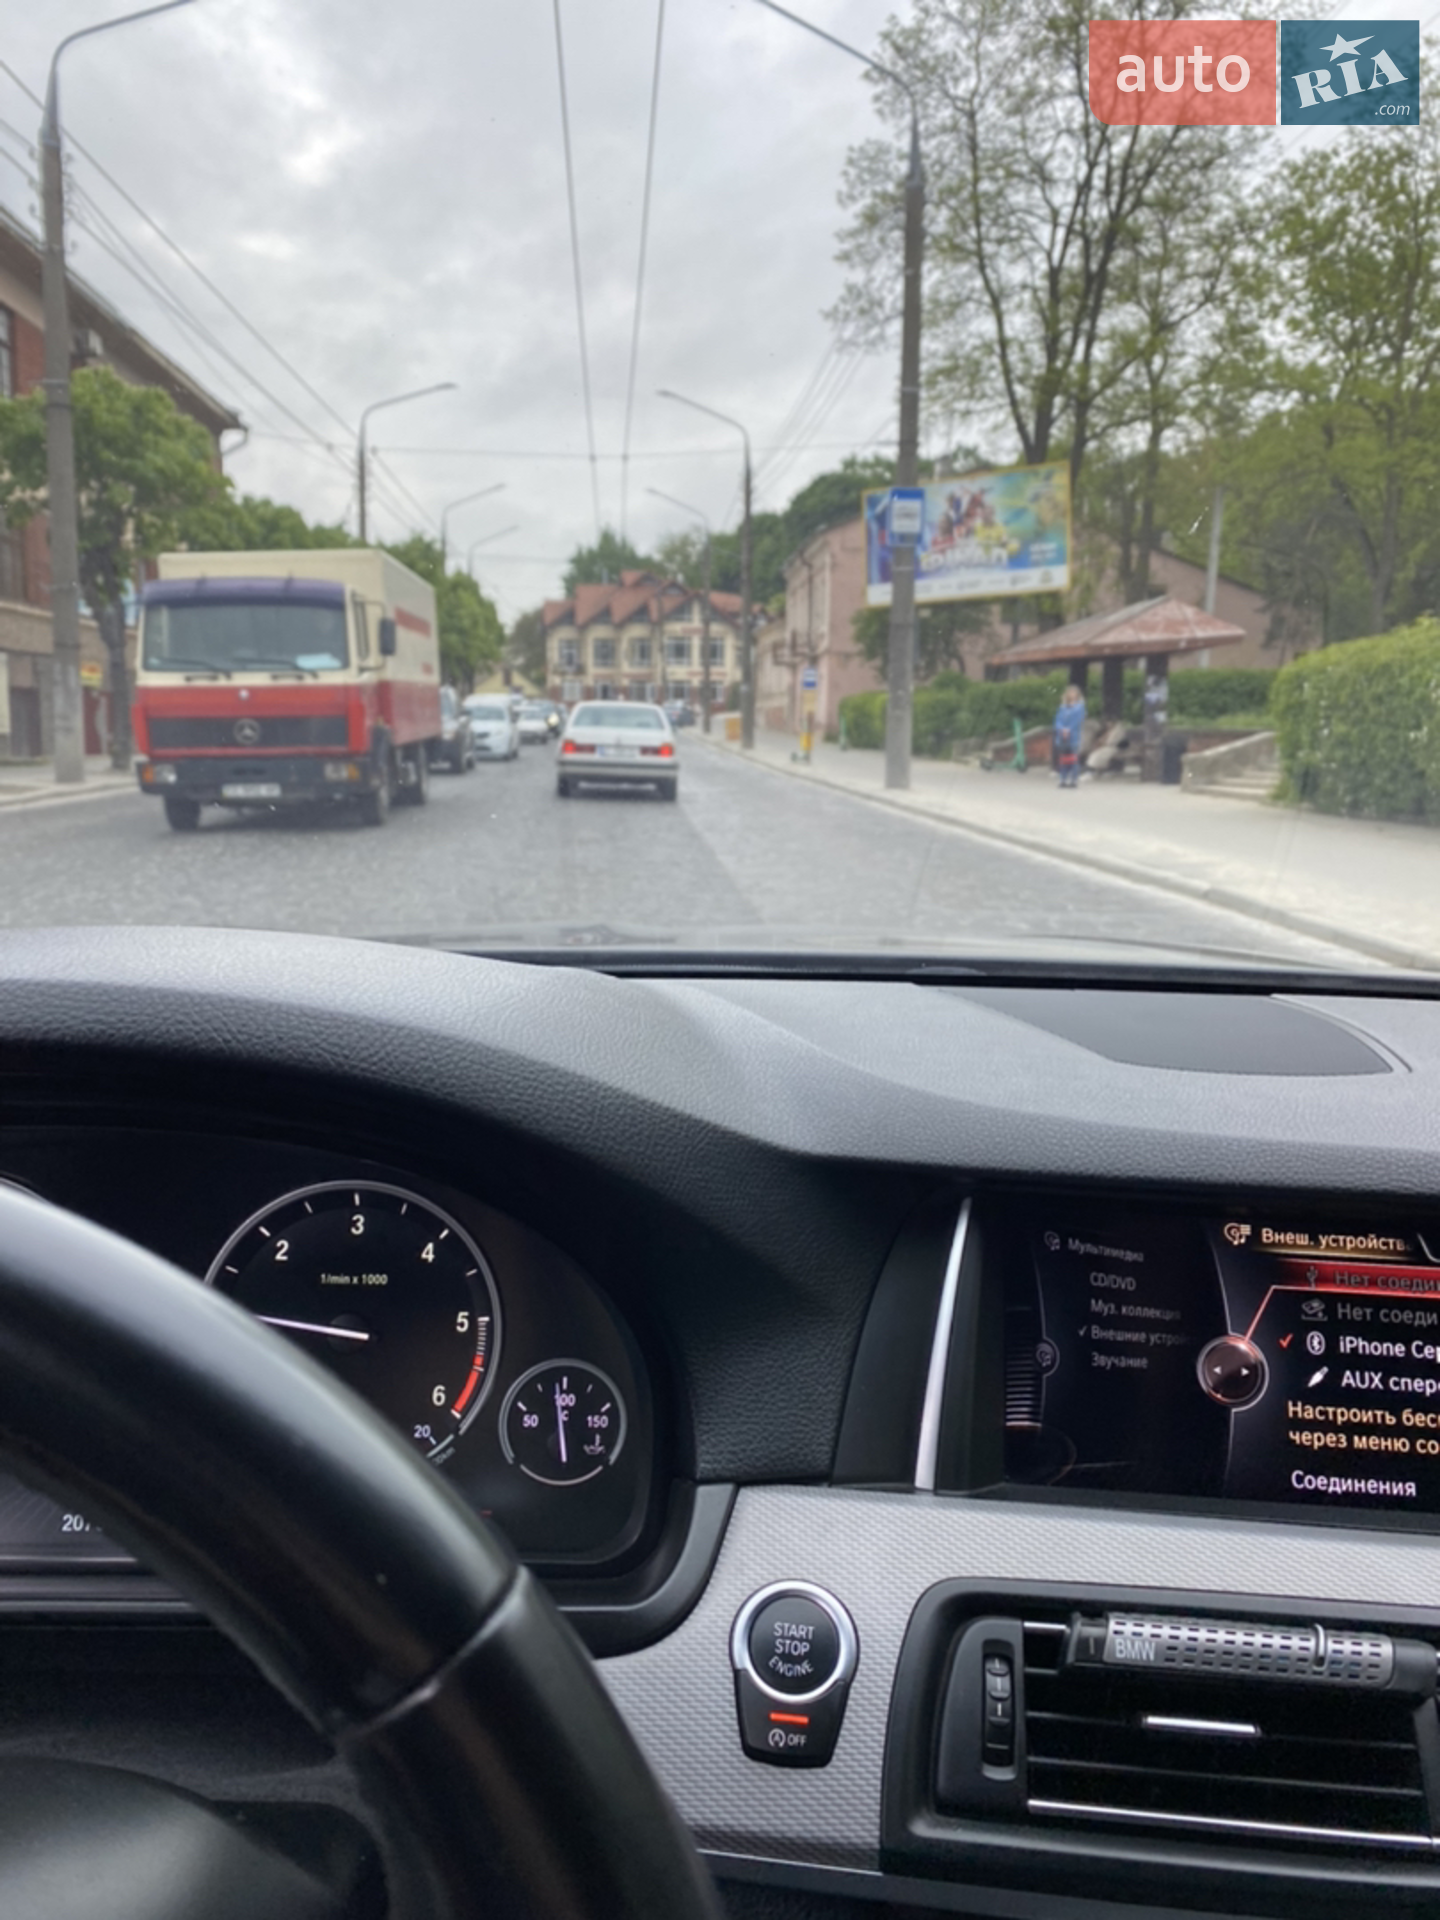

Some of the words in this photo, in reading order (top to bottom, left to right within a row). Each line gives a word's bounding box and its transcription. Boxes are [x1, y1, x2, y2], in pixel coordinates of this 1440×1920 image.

[350, 1213, 365, 1235] 3
[1261, 1227, 1314, 1246] Внеш.
[275, 1239, 290, 1261] 2
[420, 1242, 435, 1263] 4
[1067, 1237, 1144, 1263] Мультимедиа
[321, 1273, 350, 1285] 1/min
[361, 1273, 388, 1285] 1000
[1089, 1271, 1137, 1291] CD/DVD
[1334, 1271, 1371, 1288] Нет
[1090, 1298, 1118, 1317] Муз.
[1337, 1302, 1373, 1320] Нет
[456, 1311, 469, 1332] 5
[1090, 1324, 1146, 1343] Внешние
[1339, 1335, 1406, 1358] iPhone
[1091, 1351, 1148, 1370] Звучание
[1341, 1369, 1385, 1390] AUX
[1389, 1376, 1440, 1397] спер
[432, 1385, 446, 1406] 6
[522, 1414, 539, 1427] 50
[587, 1414, 609, 1428] 150
[1287, 1399, 1397, 1426] Настроить
[413, 1424, 431, 1438] 20
[1288, 1429, 1347, 1450] через
[1353, 1434, 1411, 1453] меню
[1291, 1469, 1417, 1498] Соединения
[773, 1621, 815, 1640] START
[774, 1638, 810, 1656] STOP
[1115, 1638, 1156, 1661] BMW
[768, 1655, 814, 1677] ENGINE
[787, 1733, 807, 1747] OFF
